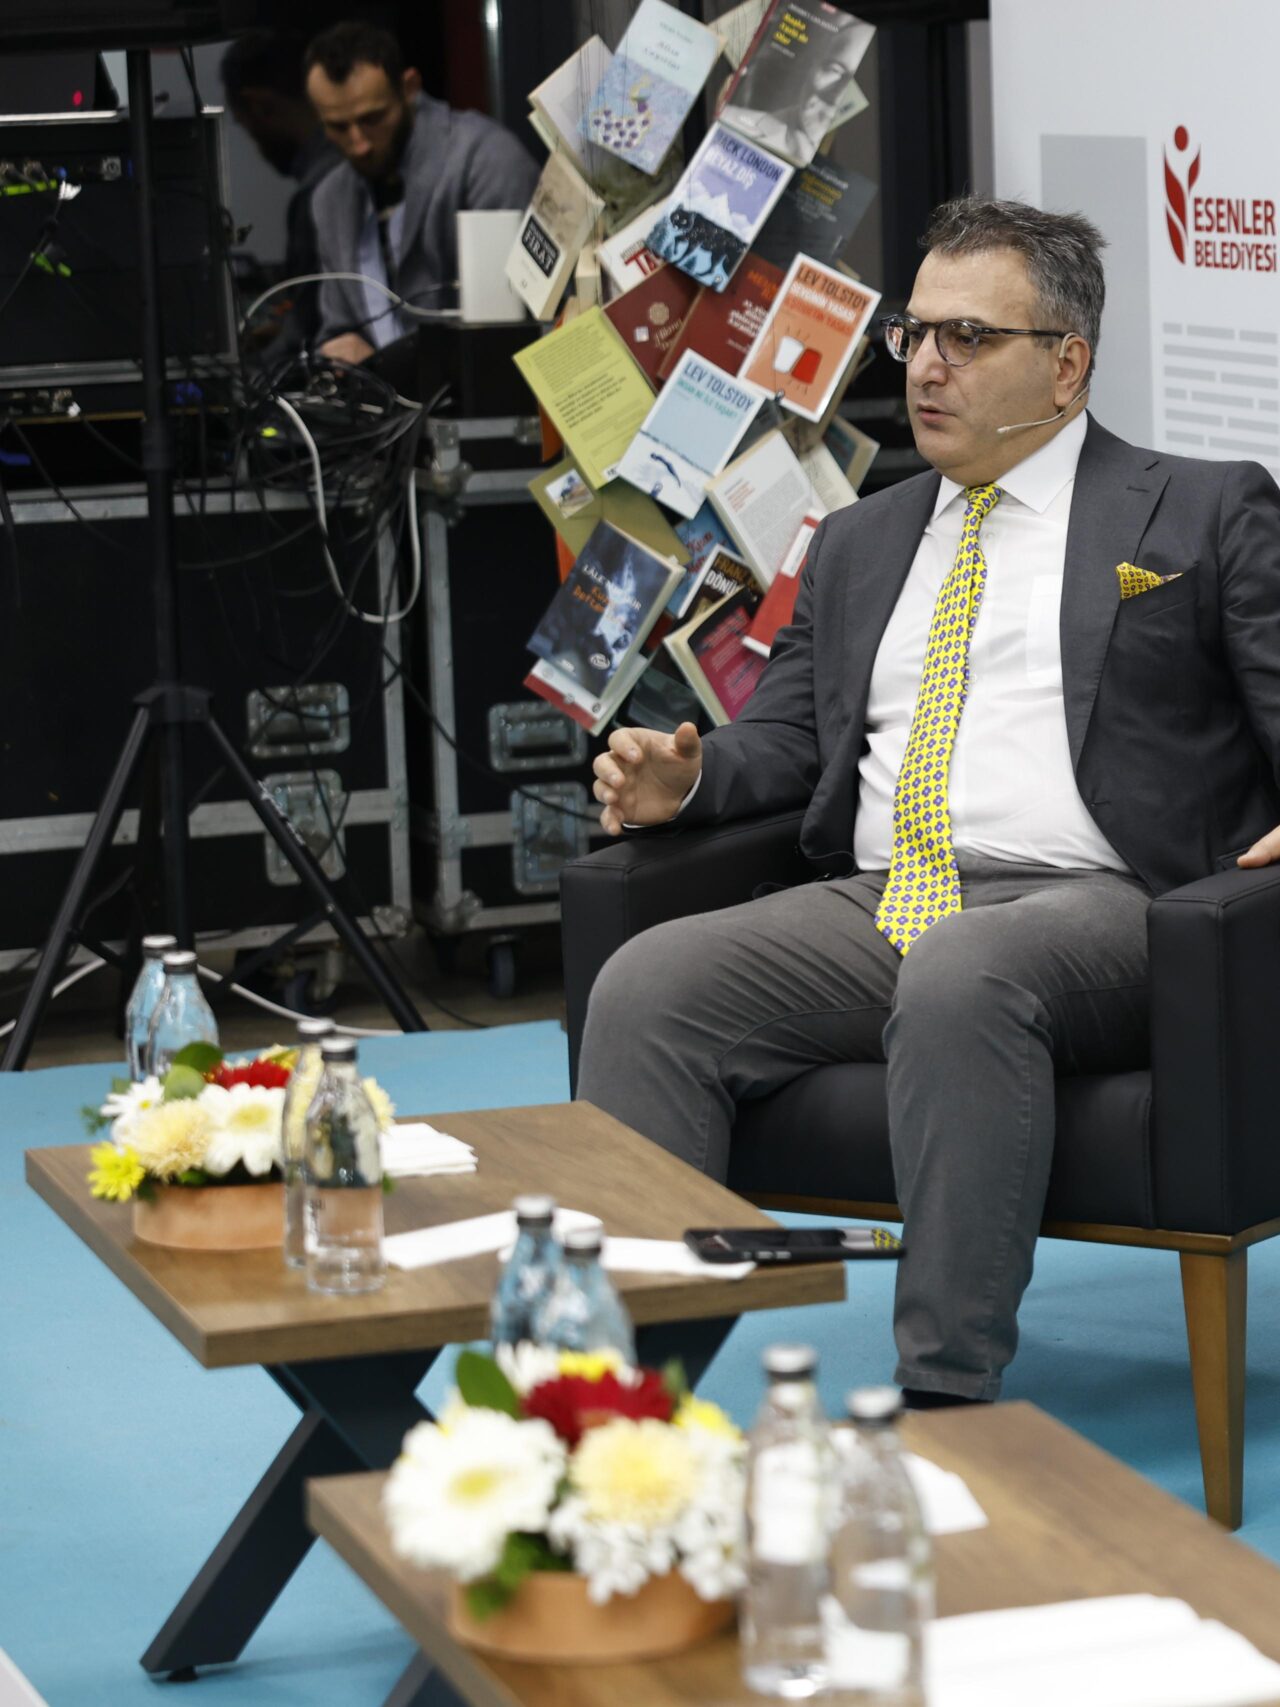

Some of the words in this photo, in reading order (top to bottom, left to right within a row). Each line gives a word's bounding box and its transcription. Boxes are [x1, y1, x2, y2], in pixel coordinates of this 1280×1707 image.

[740, 146, 785, 182] LONDON
[1193, 197, 1276, 236] ESENLER
[796, 264, 821, 287] LEV
[819, 277, 872, 313] TOLSTOY
[683, 360, 708, 383] LEV
[706, 373, 756, 413] TOLSTOY
